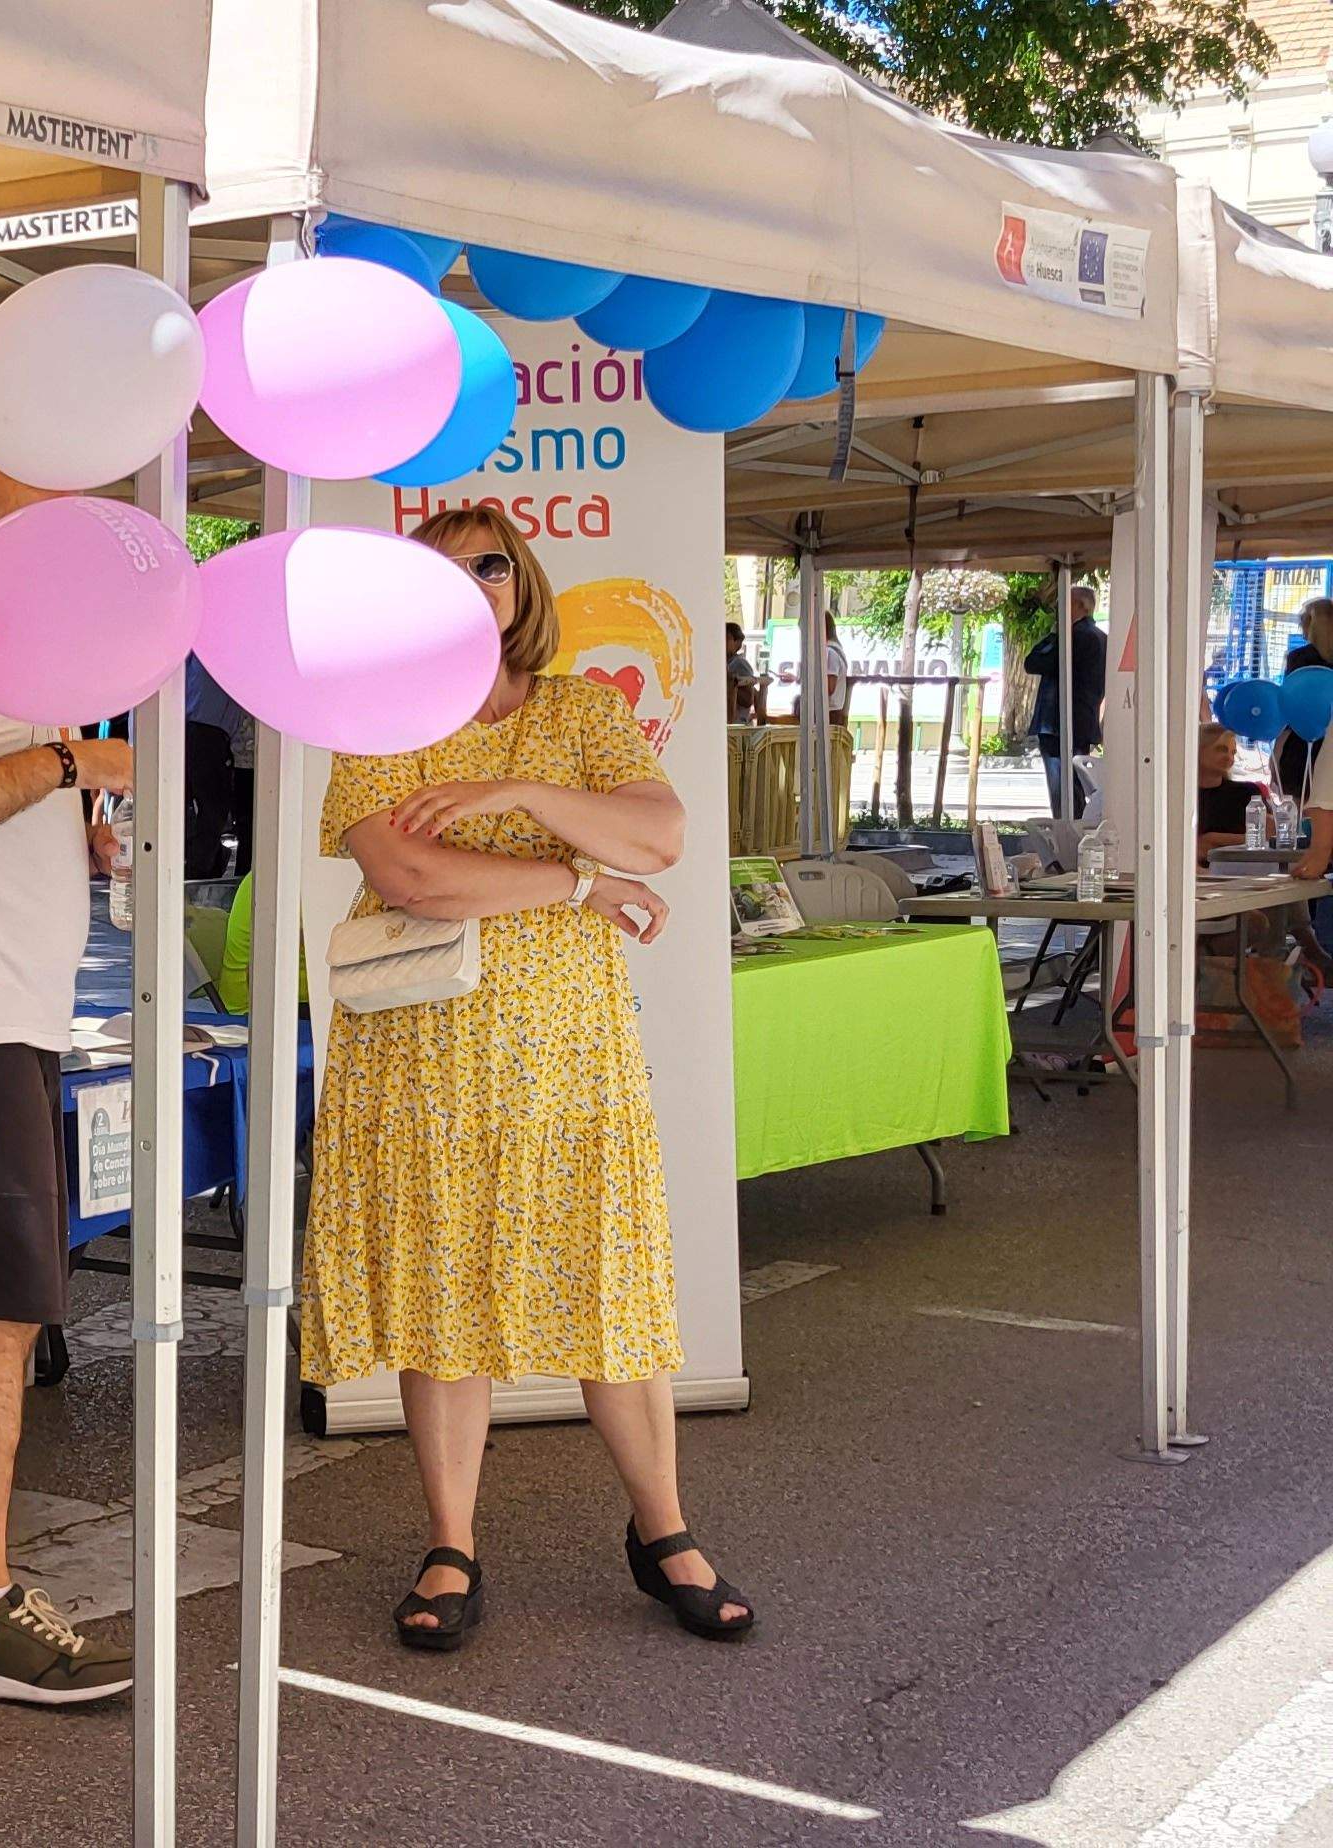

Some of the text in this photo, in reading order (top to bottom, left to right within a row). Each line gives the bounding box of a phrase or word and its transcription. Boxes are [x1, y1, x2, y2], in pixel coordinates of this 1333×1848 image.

[6, 107, 134, 160] MASTERTENT
[1036, 262, 1063, 282] Huesca
[513, 344, 643, 405] ació
[393, 486, 612, 541] Hsca
[92, 1142, 106, 1157] Día
[92, 1159, 104, 1173] de
[93, 1174, 116, 1190] sobre
[117, 1171, 125, 1186] el
